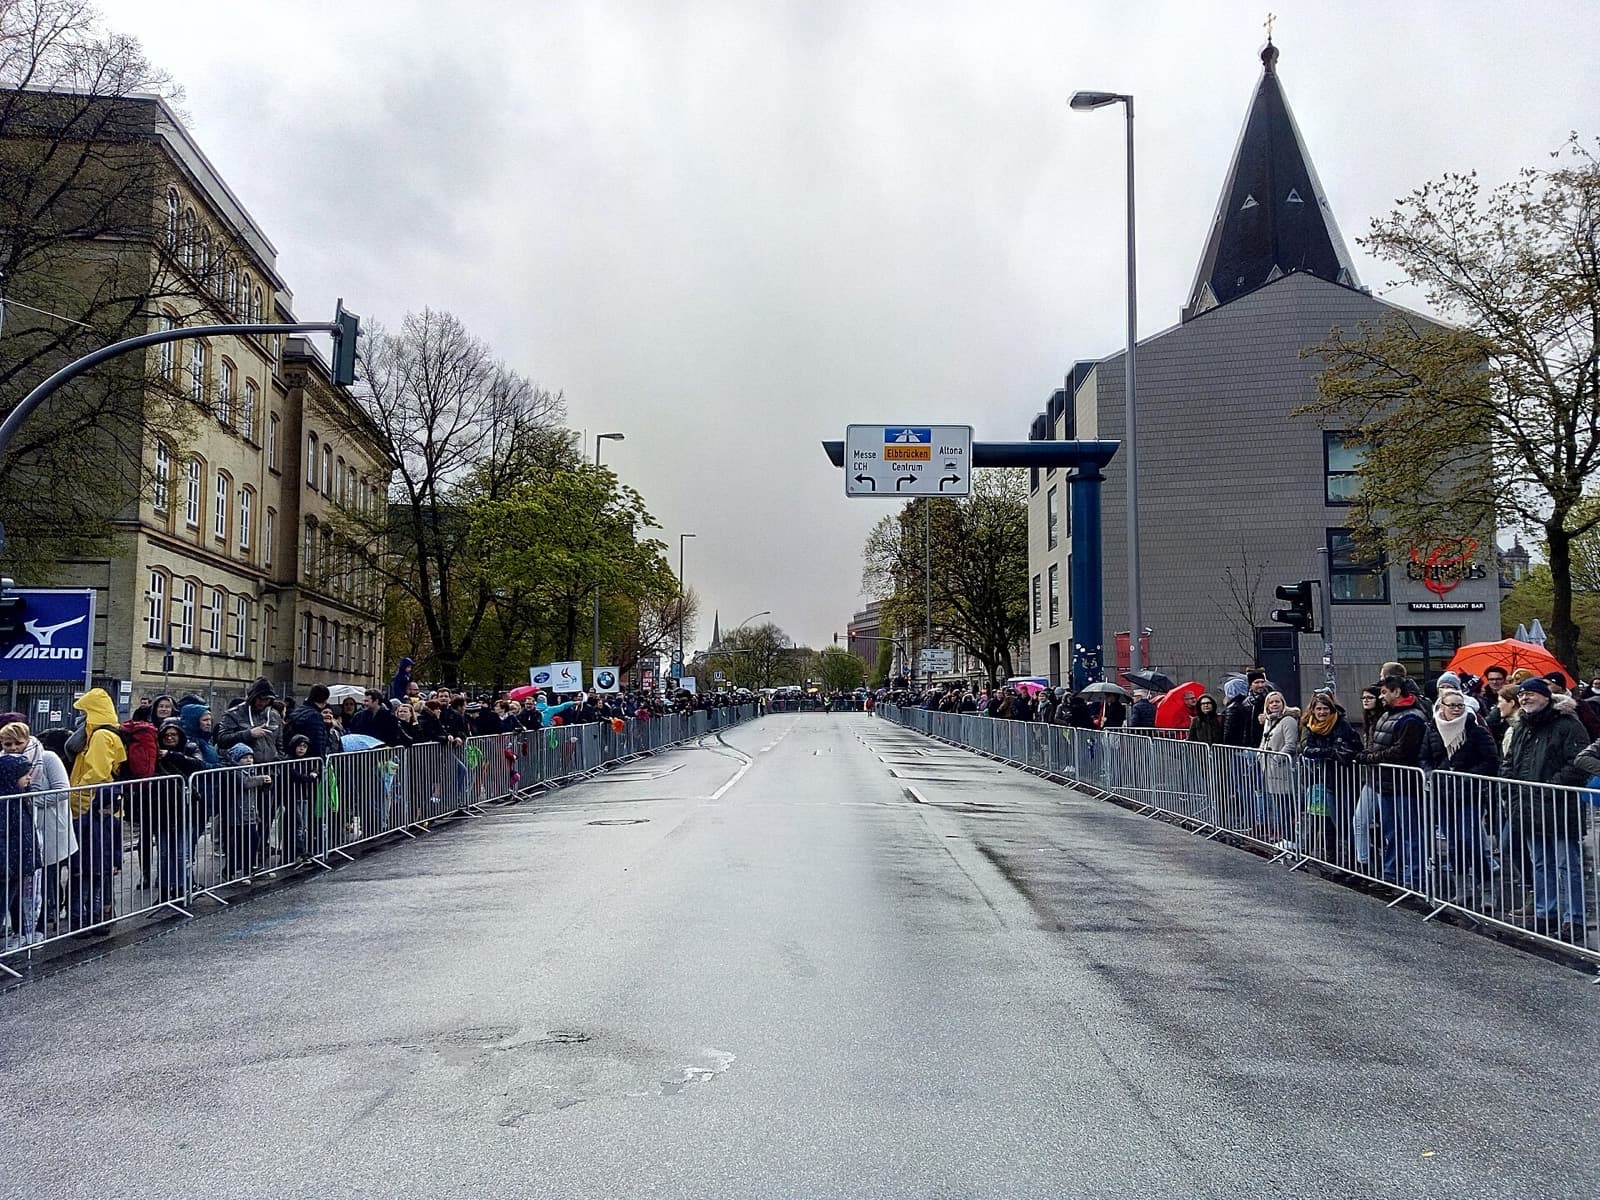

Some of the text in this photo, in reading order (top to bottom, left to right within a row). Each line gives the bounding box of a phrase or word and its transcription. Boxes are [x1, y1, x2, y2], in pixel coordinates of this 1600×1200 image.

[853, 450, 877, 459] Messe
[887, 448, 929, 458] Elbbrücken
[939, 446, 963, 455] Altona
[853, 462, 868, 471] CCH
[892, 462, 923, 472] Centrum
[4, 644, 83, 659] MIZUNO
